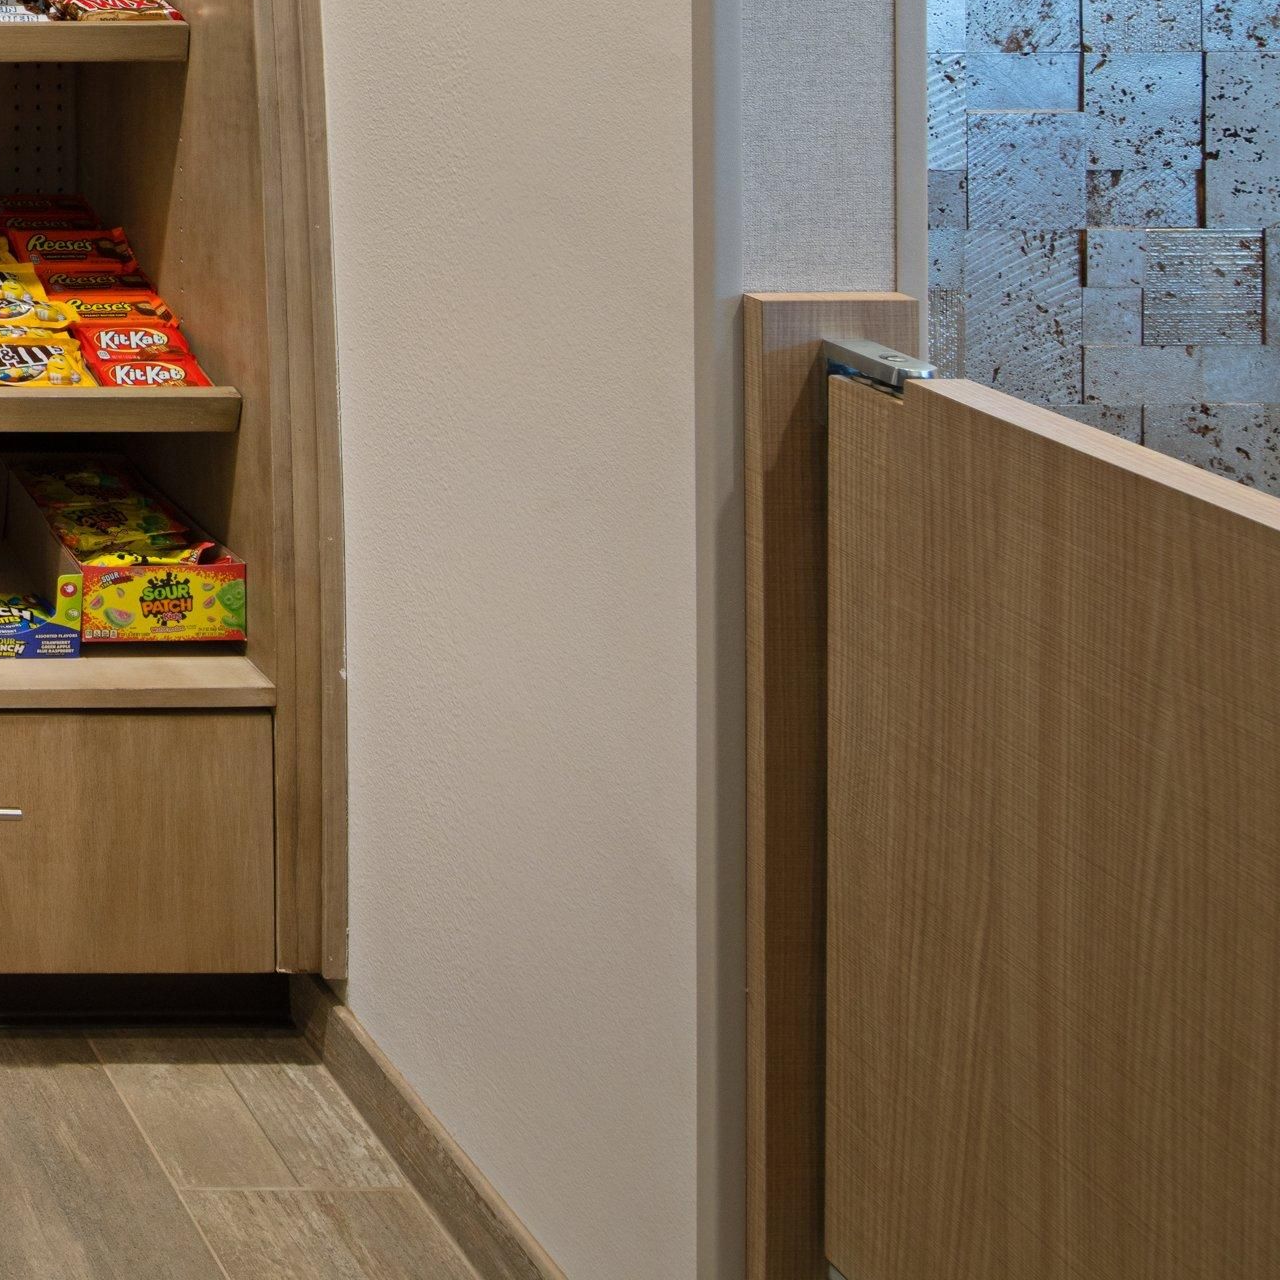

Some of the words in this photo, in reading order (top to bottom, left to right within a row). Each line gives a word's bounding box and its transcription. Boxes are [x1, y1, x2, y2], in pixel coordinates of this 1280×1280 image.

[28, 234, 93, 252] Reese's
[67, 298, 133, 314] Reese's
[142, 584, 191, 600] SOUR
[140, 599, 193, 616] PATCH
